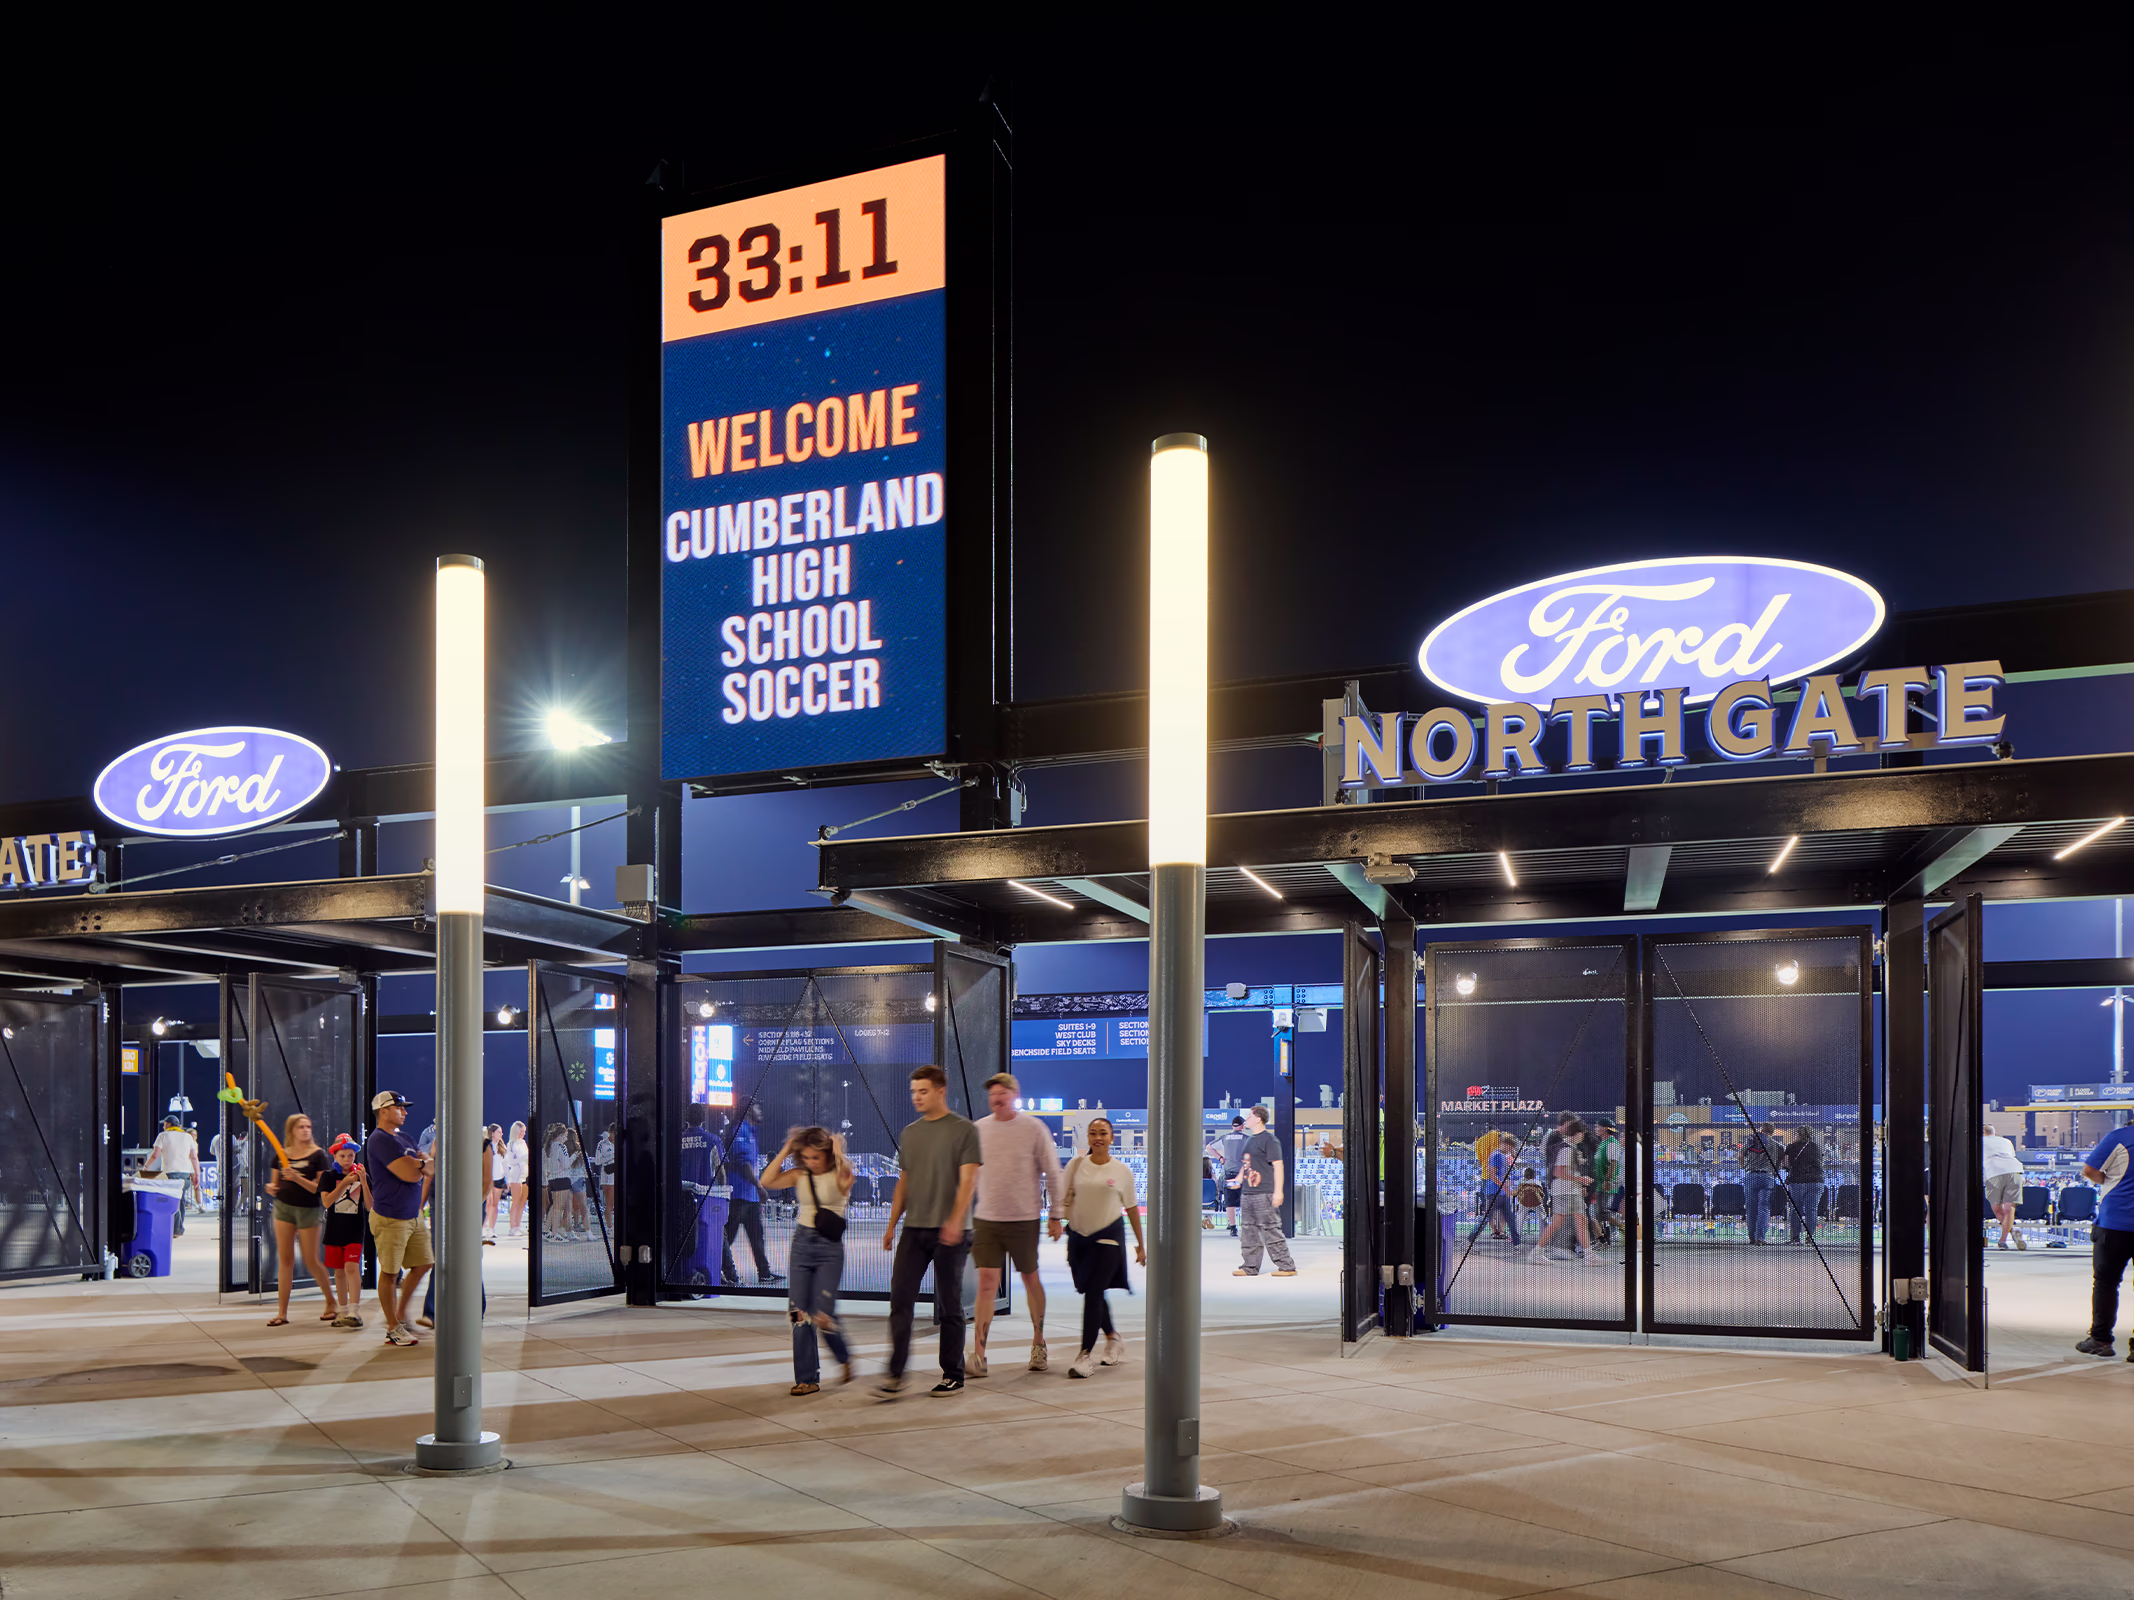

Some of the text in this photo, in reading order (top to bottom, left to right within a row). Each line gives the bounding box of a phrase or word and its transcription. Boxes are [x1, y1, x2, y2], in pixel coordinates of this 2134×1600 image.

[688, 197, 899, 314] 33:11
[688, 383, 919, 479] WELCOME
[665, 472, 945, 563] CUMBERLAND
[751, 543, 851, 607] HIGH
[720, 599, 883, 668] SCHOOL
[1500, 576, 1792, 694] Ford
[721, 657, 880, 725] SOCCER
[1339, 659, 2007, 787] NORTH GATE
[136, 740, 285, 821] Ford
[1011, 1048, 1050, 1056] BENCHSIDE
[1073, 1047, 1096, 1055] SEATS
[1058, 1022, 1096, 1031] SUITES 1-9
[1072, 1039, 1096, 1047] DECKS
[681, 1135, 703, 1143] GUEST
[1441, 1100, 1544, 1112] MARKET PLAZA
[681, 1141, 707, 1149] ERVICES
